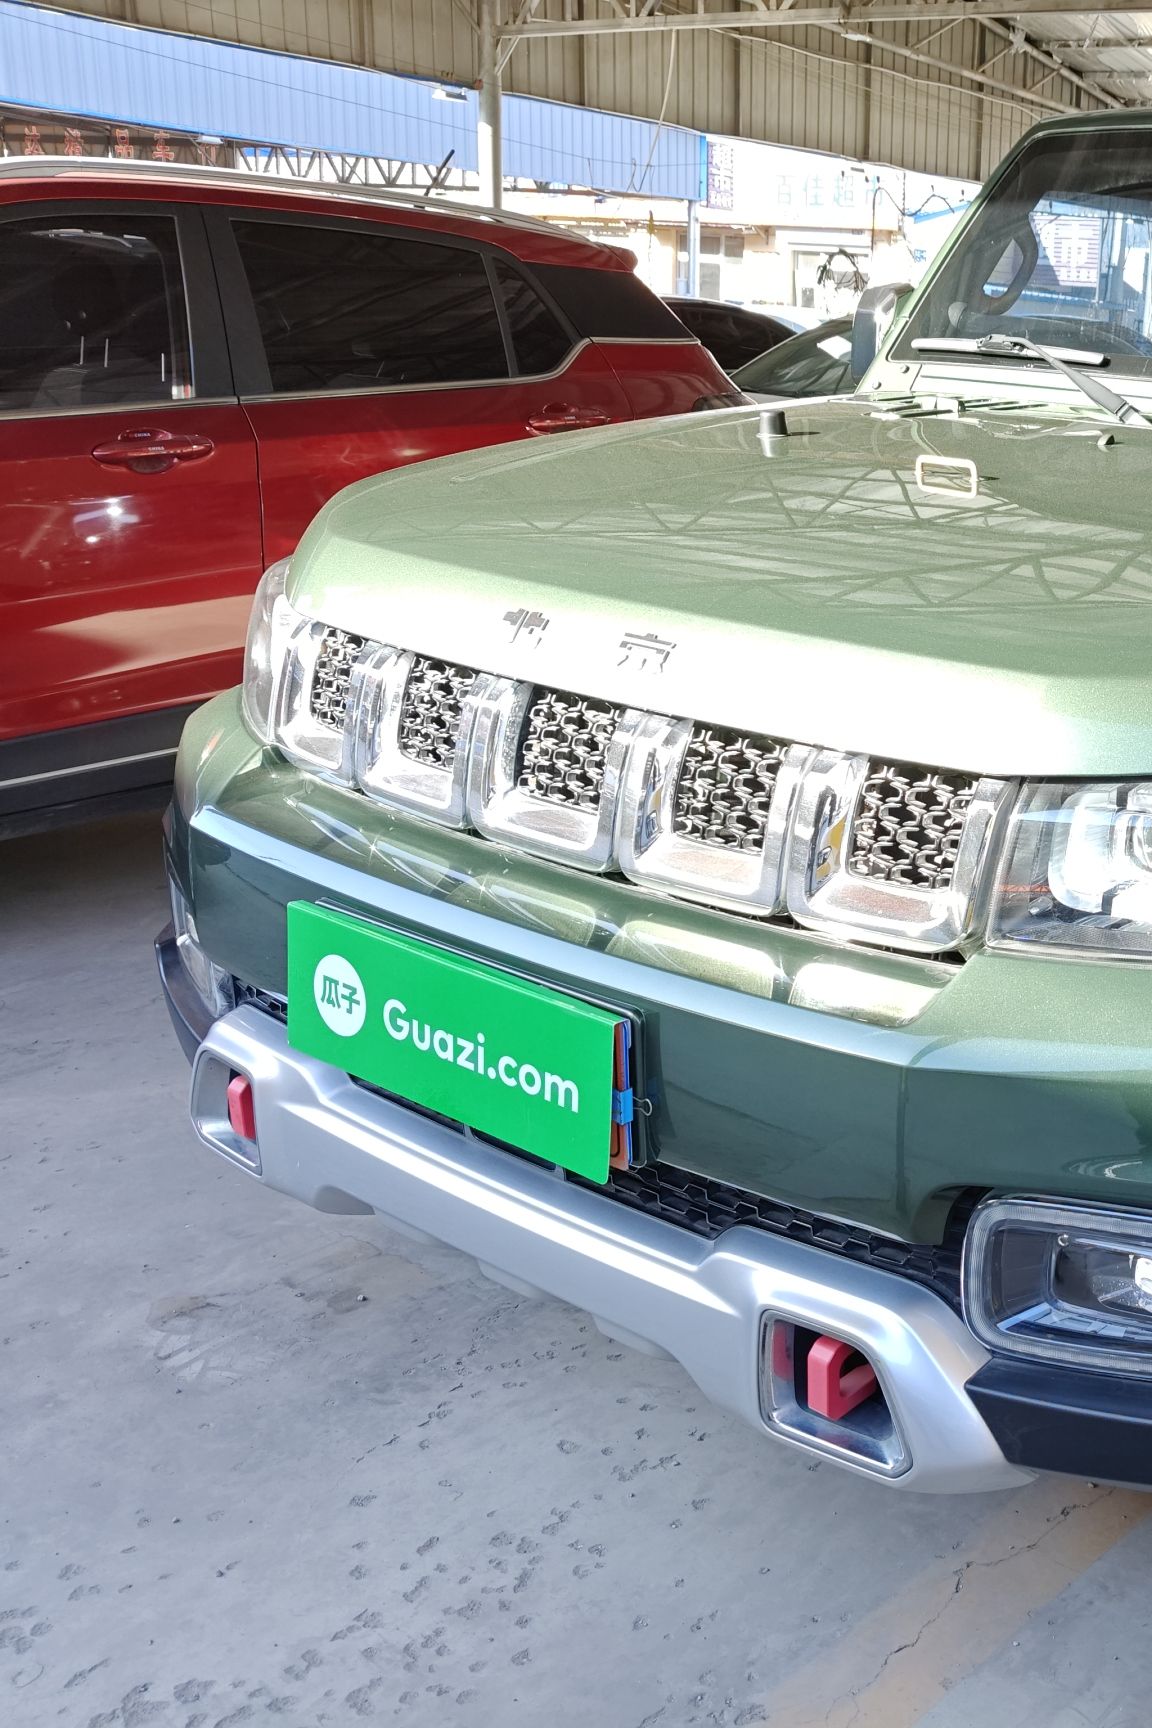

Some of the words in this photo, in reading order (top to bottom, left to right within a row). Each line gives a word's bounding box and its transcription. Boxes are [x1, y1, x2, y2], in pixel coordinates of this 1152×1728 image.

[776, 174, 884, 208] 百佳超市
[502, 608, 677, 674] 北京
[320, 974, 361, 1015] 瓜子
[382, 998, 580, 1114] Guazi.com
